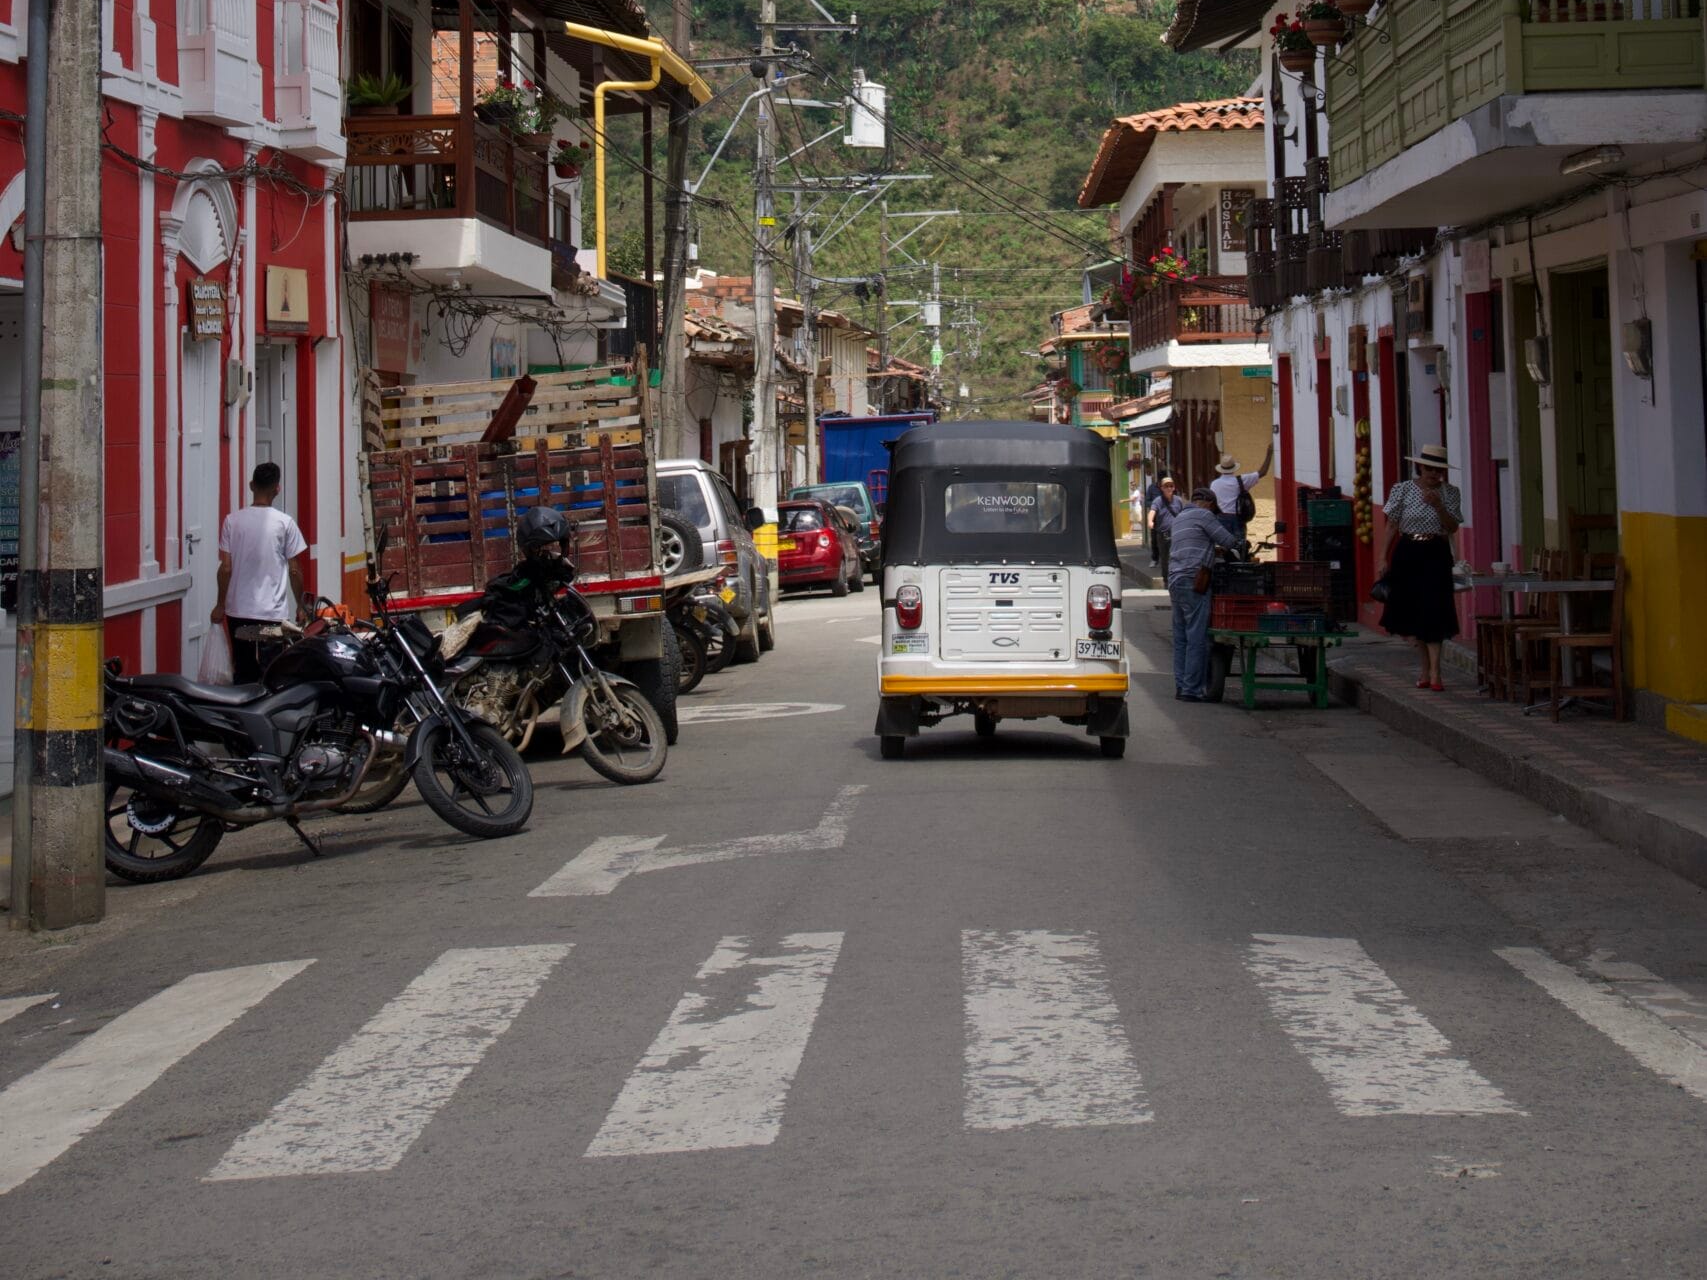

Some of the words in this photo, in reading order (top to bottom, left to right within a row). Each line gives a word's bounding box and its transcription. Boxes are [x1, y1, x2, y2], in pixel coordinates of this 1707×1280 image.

[1222, 190, 1232, 250] HOSTAL
[977, 495, 1035, 506] KENWOOD
[989, 572, 1020, 584] TVS
